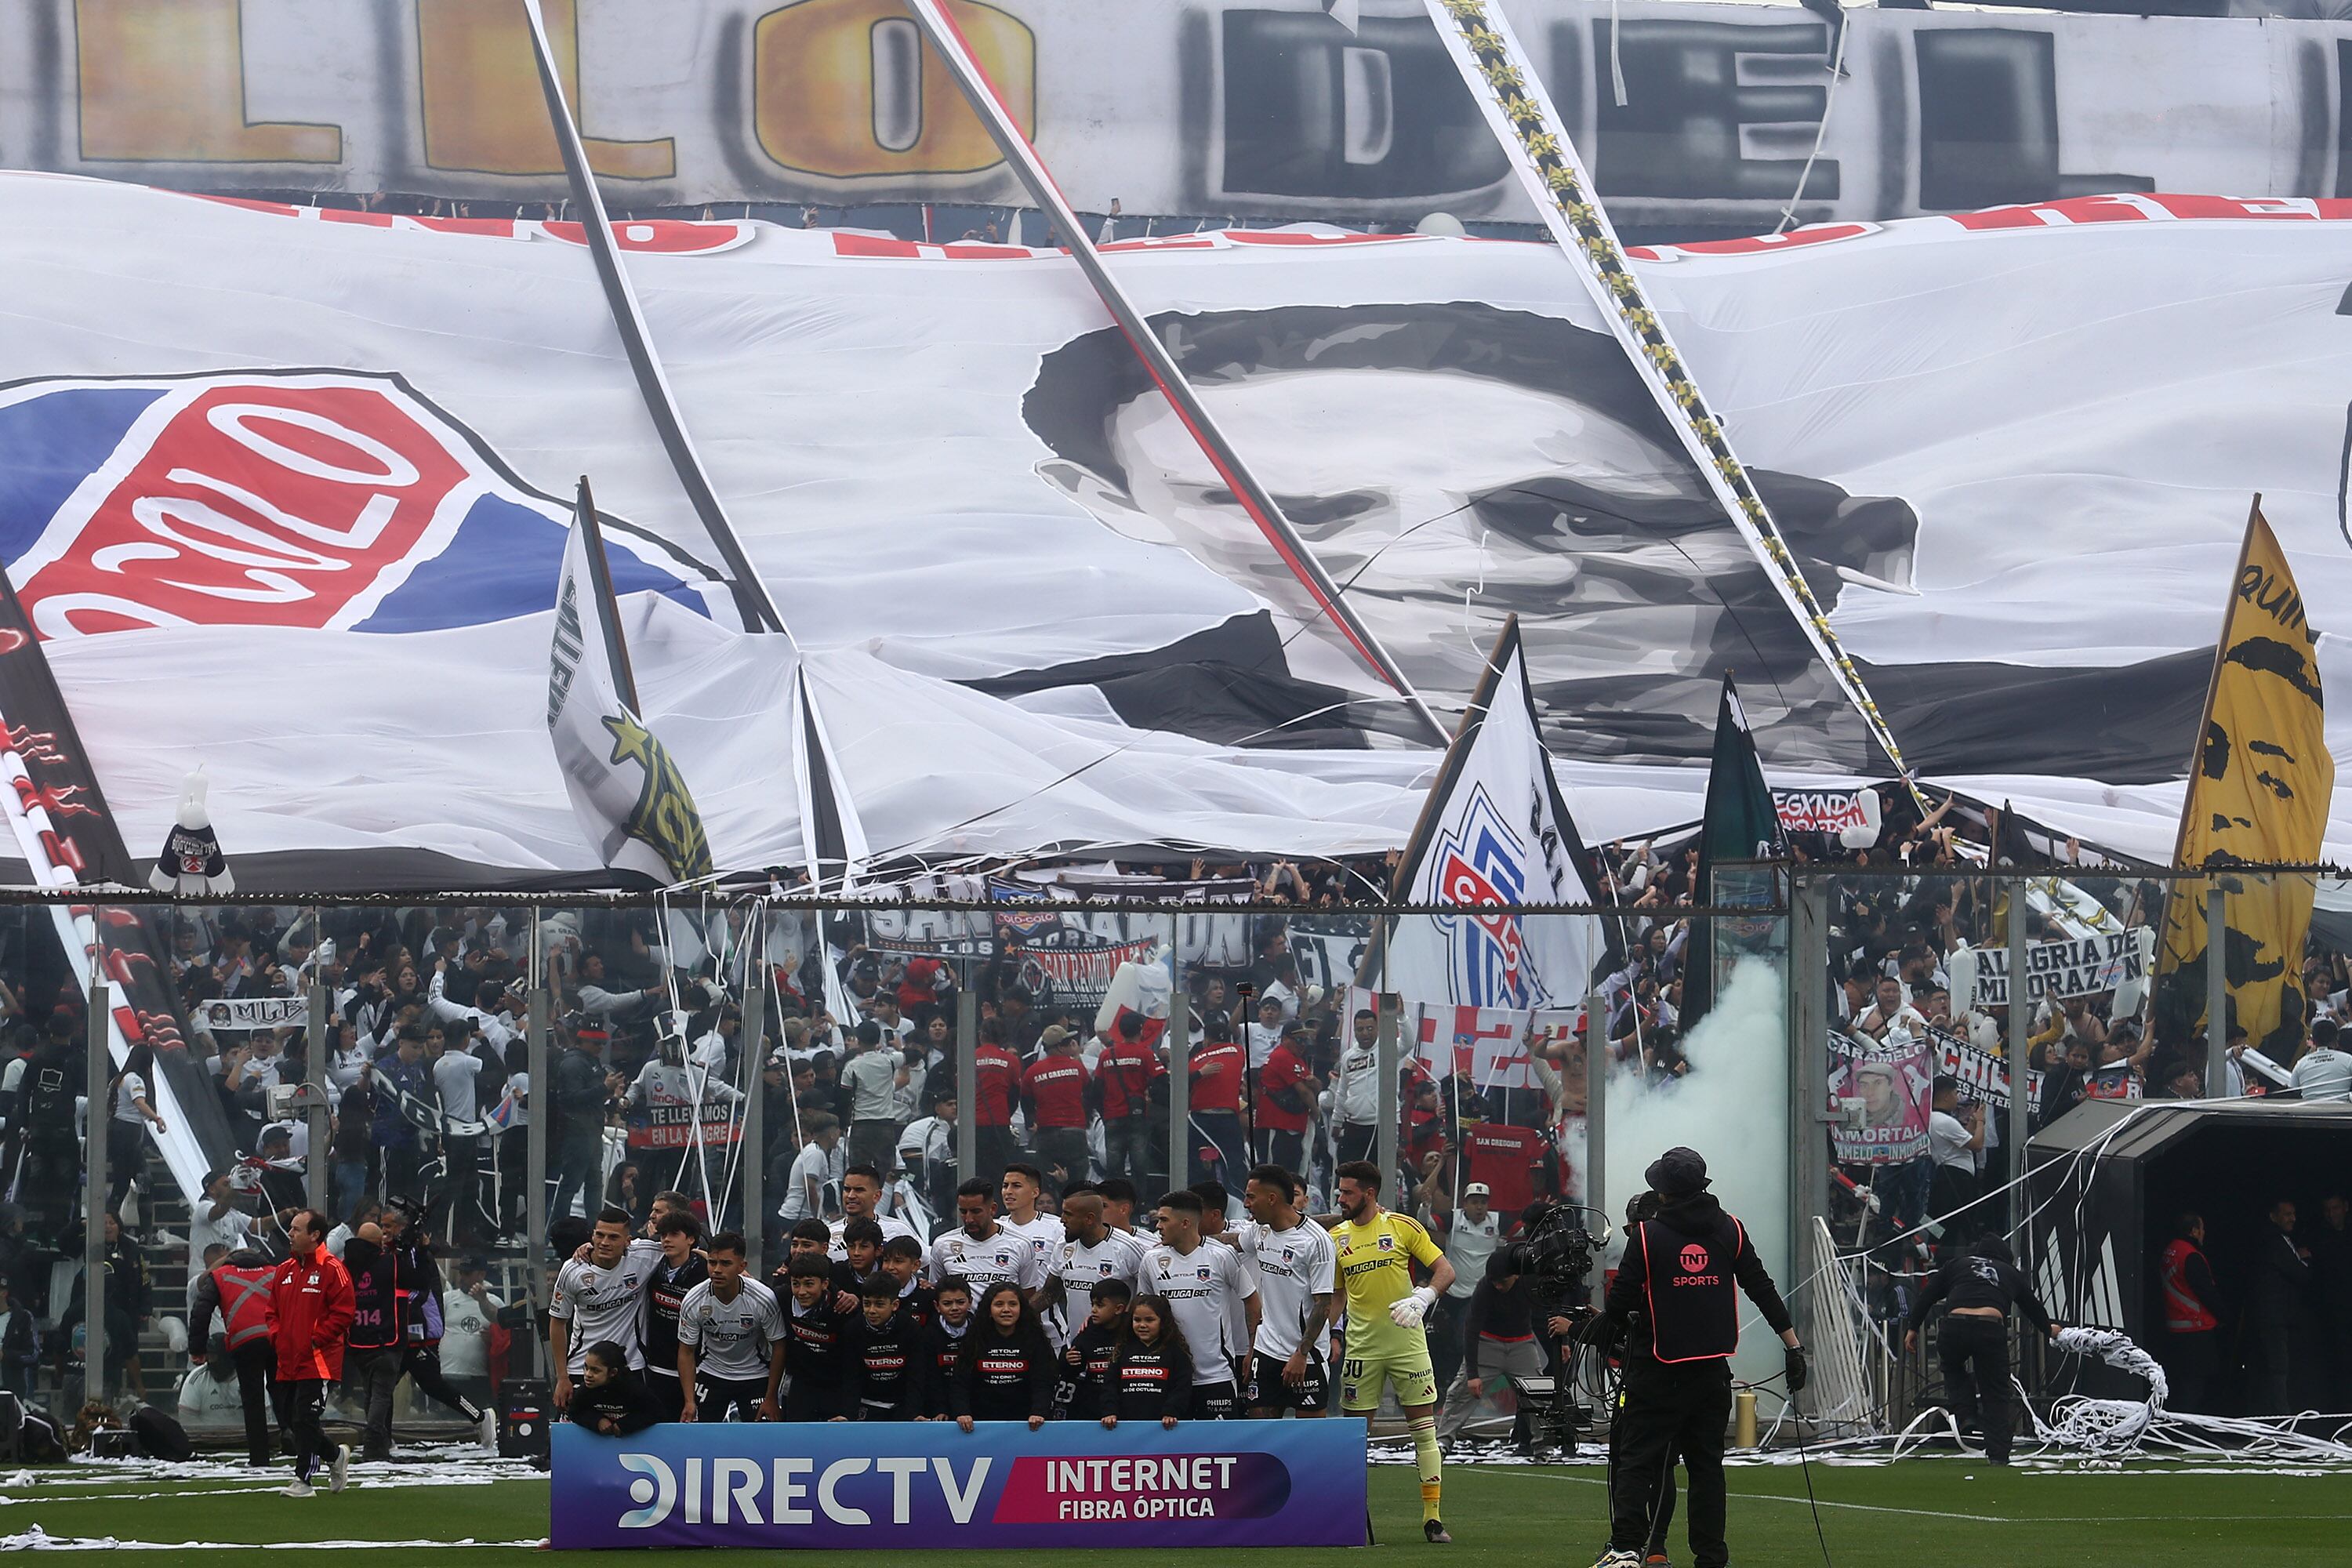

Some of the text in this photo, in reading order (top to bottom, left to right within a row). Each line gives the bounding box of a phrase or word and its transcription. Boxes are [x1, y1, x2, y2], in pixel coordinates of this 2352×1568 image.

[940, 942, 993, 954] LOS
[1976, 928, 2139, 978] ALGRIA DE
[2027, 955, 2143, 999] ORAZN
[1828, 1037, 1926, 1064] CARAMELO
[1034, 1073, 1048, 1083] SAN
[651, 1107, 666, 1125] TE
[652, 1129, 666, 1145] EN
[669, 1127, 684, 1145] LA
[1476, 1137, 1490, 1146] SAN
[1673, 1276, 1719, 1286] SPORTS
[1251, 1357, 1258, 1379] 9
[1055, 1380, 1076, 1403] 23
[1047, 1457, 1237, 1493] INTERNET
[619, 1454, 993, 1528] DIRECTV
[1059, 1495, 1215, 1519] FIBRA ÓPTICA
